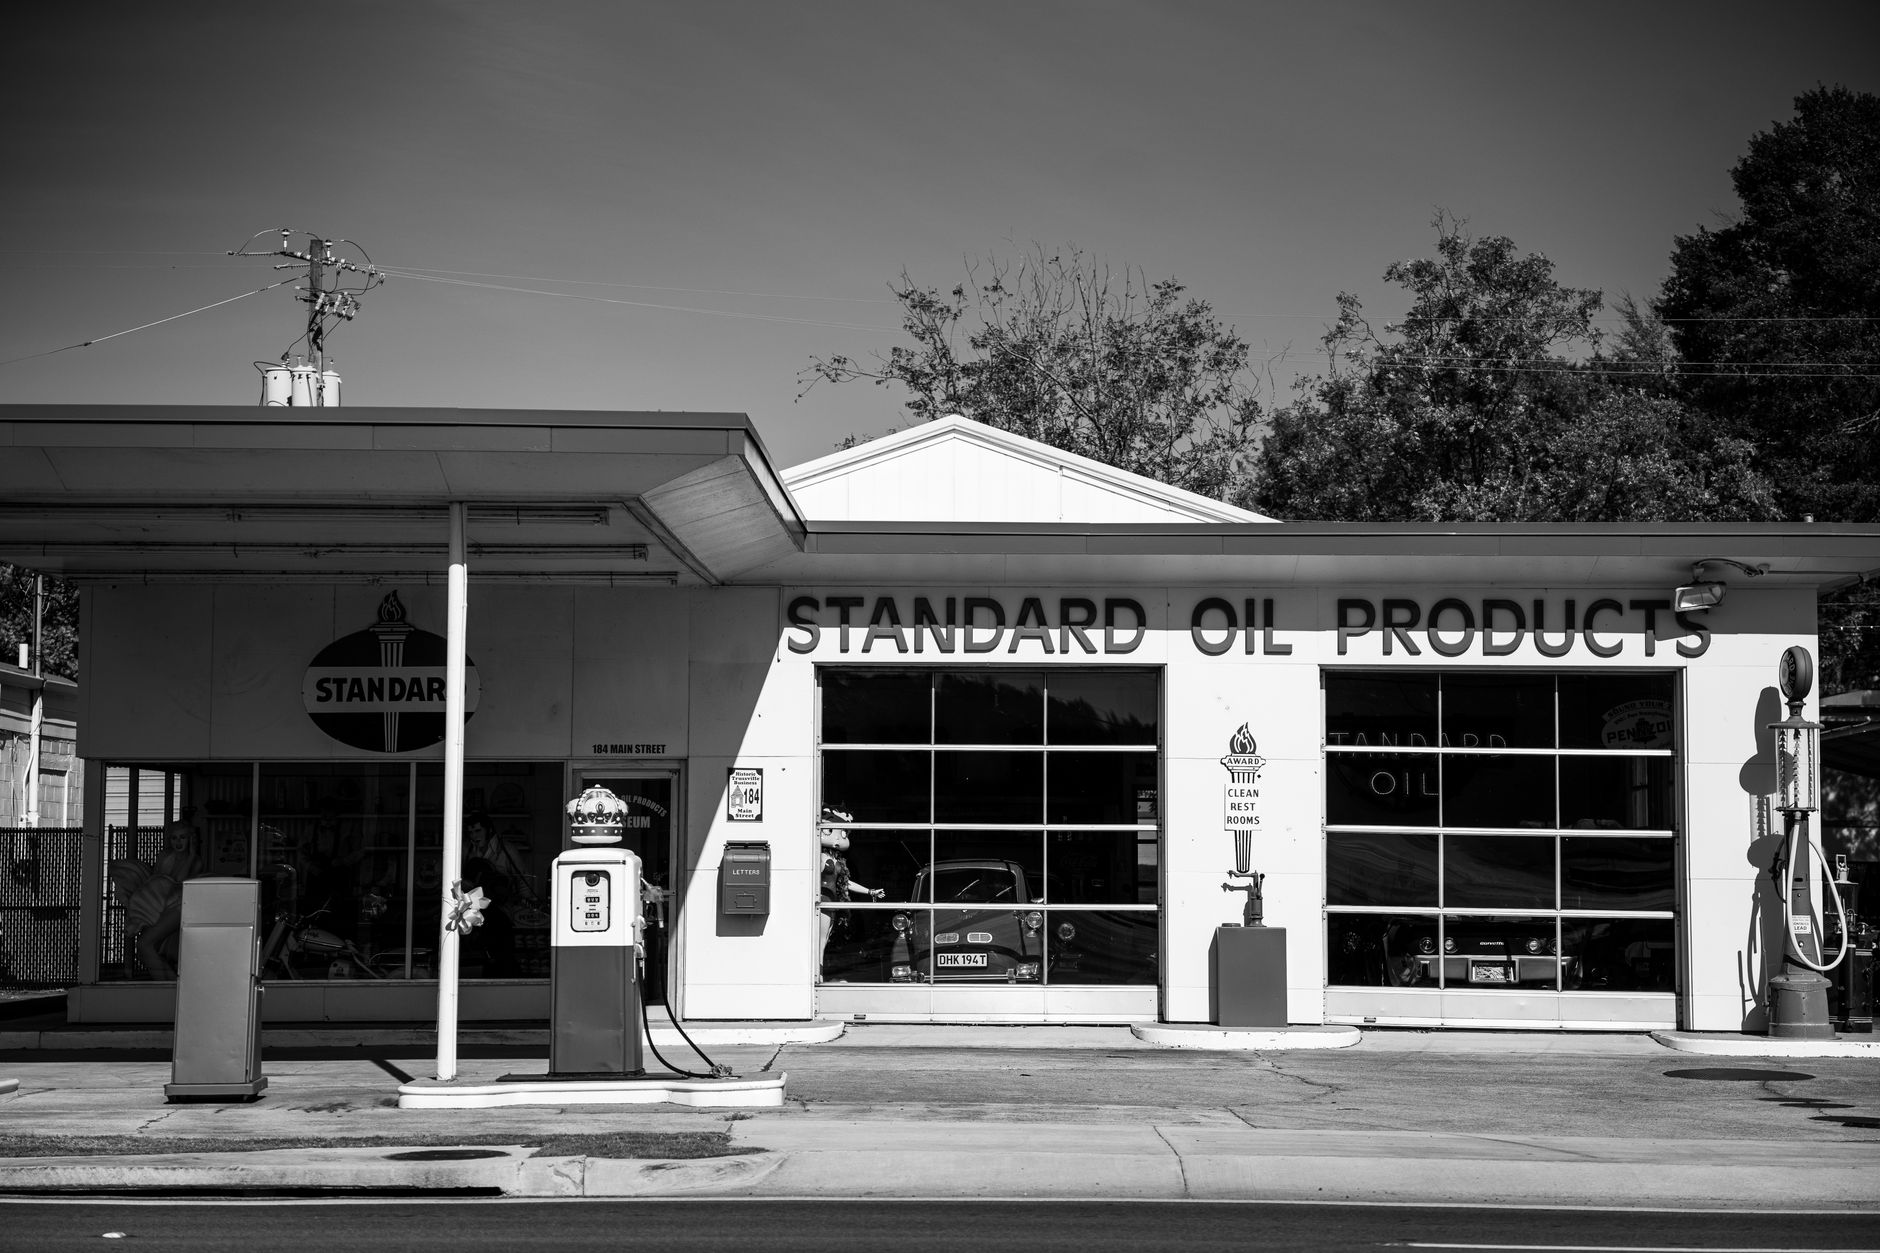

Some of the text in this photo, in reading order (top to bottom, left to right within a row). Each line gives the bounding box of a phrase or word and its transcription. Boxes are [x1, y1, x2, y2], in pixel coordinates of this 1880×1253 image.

[787, 597, 1712, 659] STANDARD OIL PRODUCTS
[315, 677, 449, 703] STANDAR
[1606, 719, 1673, 743] PENNZOI
[592, 744, 667, 754] 184 MAIN STREET
[1328, 732, 1507, 758] TANDARD
[1371, 771, 1439, 796] OIL
[744, 788, 759, 804] 184
[1227, 788, 1259, 798] CLEAN
[633, 795, 667, 817] PRODUCTS
[1230, 802, 1256, 811] REST
[621, 815, 651, 829] SEUM
[1226, 815, 1260, 825] ROOMS
[939, 954, 986, 965] DHK 194T
